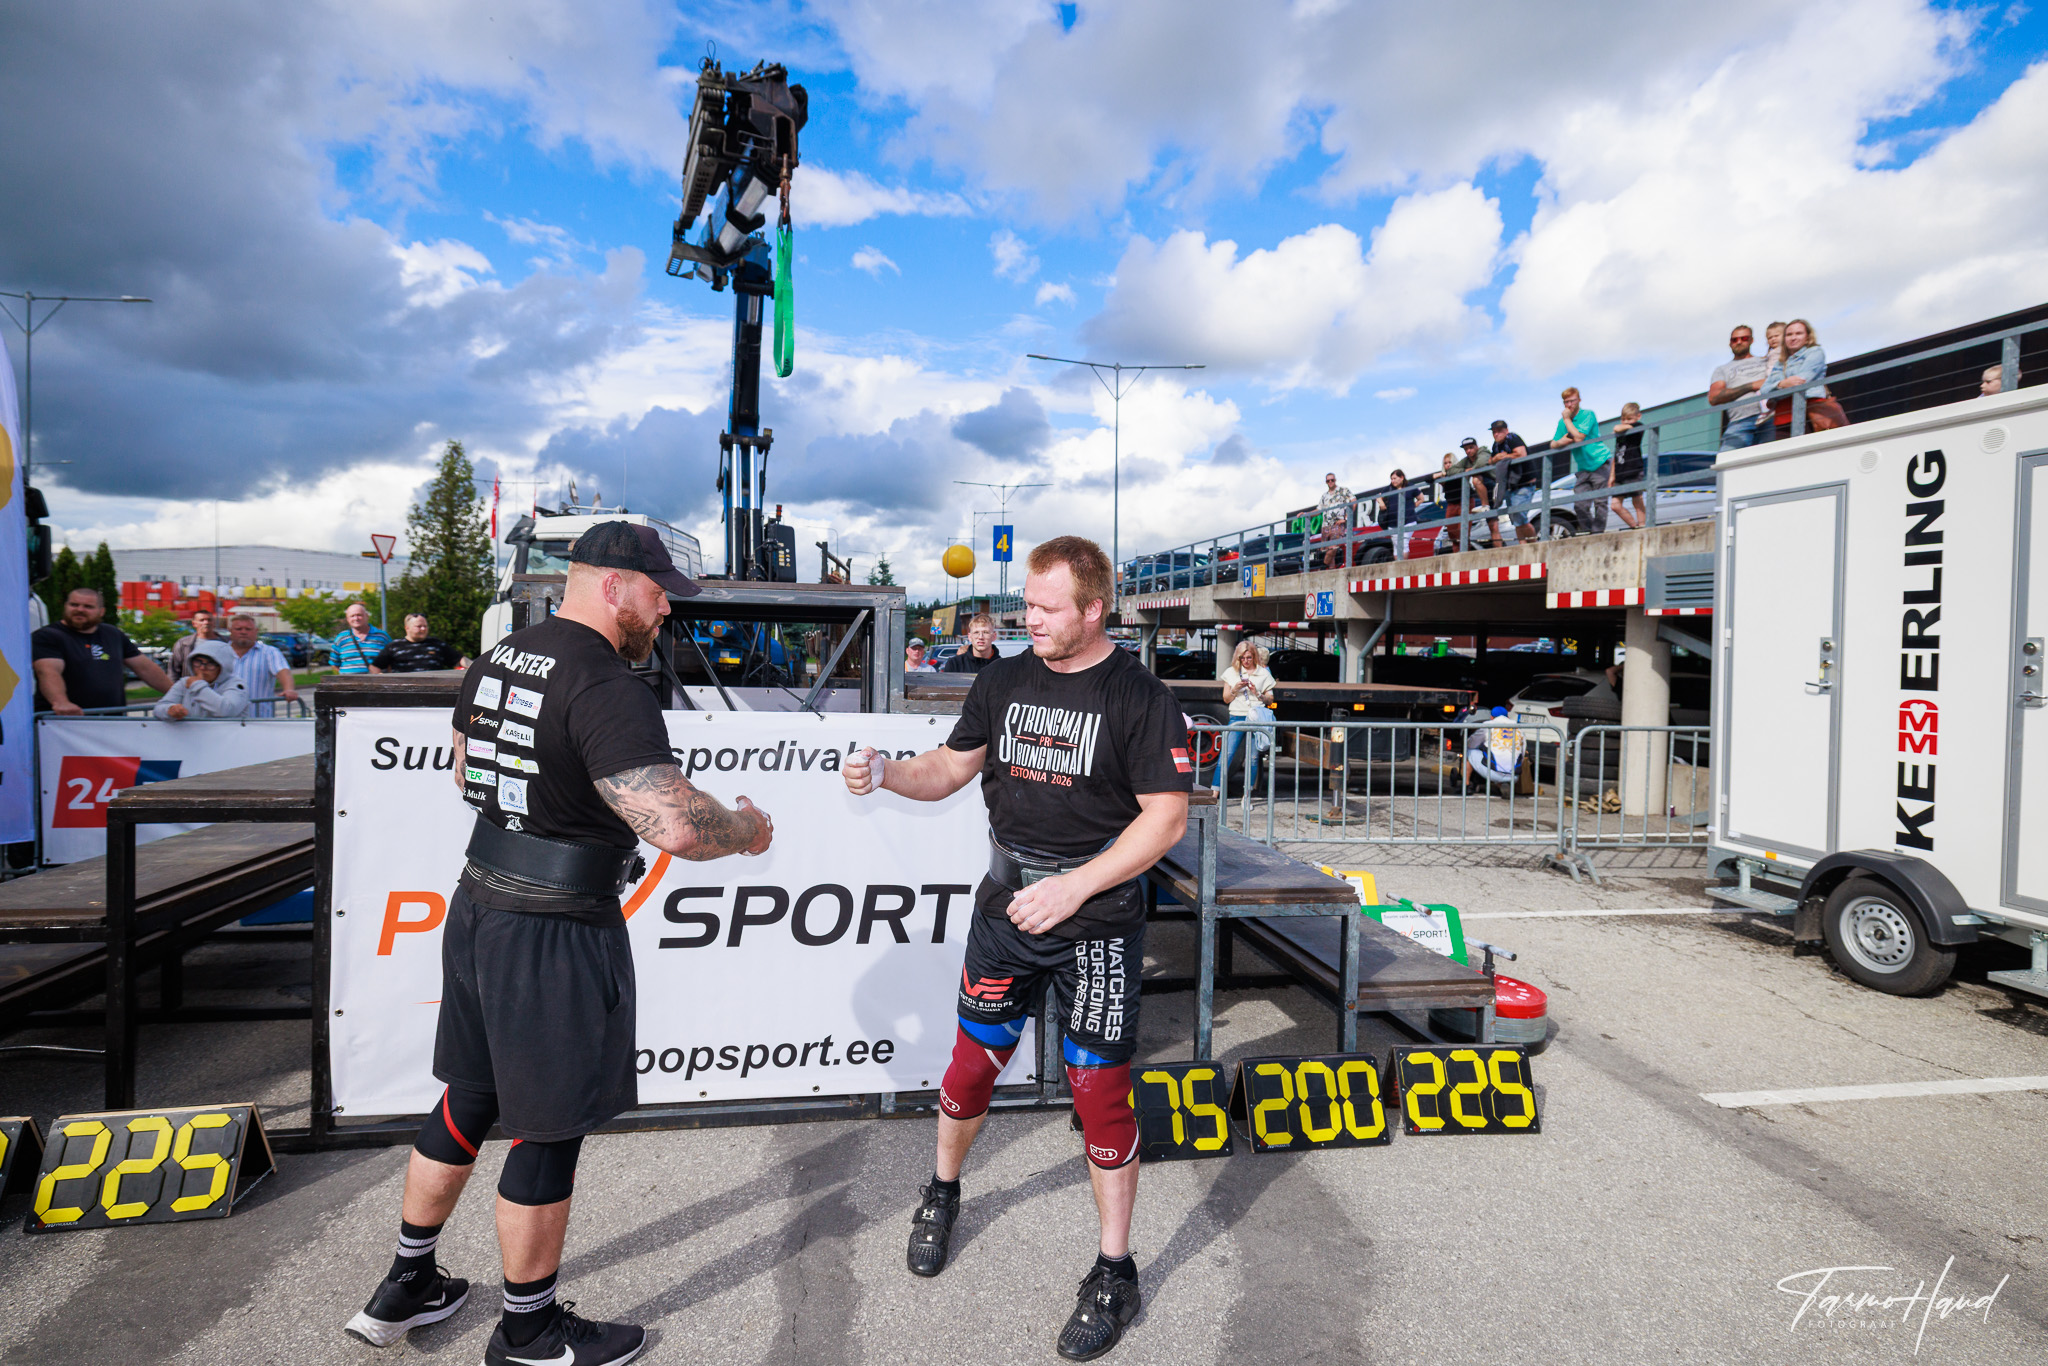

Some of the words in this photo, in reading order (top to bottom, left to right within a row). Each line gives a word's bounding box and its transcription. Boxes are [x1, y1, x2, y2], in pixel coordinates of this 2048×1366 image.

[996, 533, 1010, 553] 4
[998, 728, 1101, 777] STRONGWOMAN
[999, 702, 1102, 756] STRONGMAN
[66, 777, 120, 810] 24
[1010, 765, 1047, 783] ESTONIA
[1050, 774, 1073, 787] 2026
[658, 883, 972, 949] SPORT
[978, 1000, 1014, 1008] EUROPE
[635, 1034, 895, 1081] popsport.ee
[1128, 1068, 1229, 1151] 75
[1252, 1060, 1386, 1143] 200
[1406, 1049, 1536, 1129] 225
[33, 1113, 233, 1224] 225
[1091, 1145, 1116, 1160] SBD
